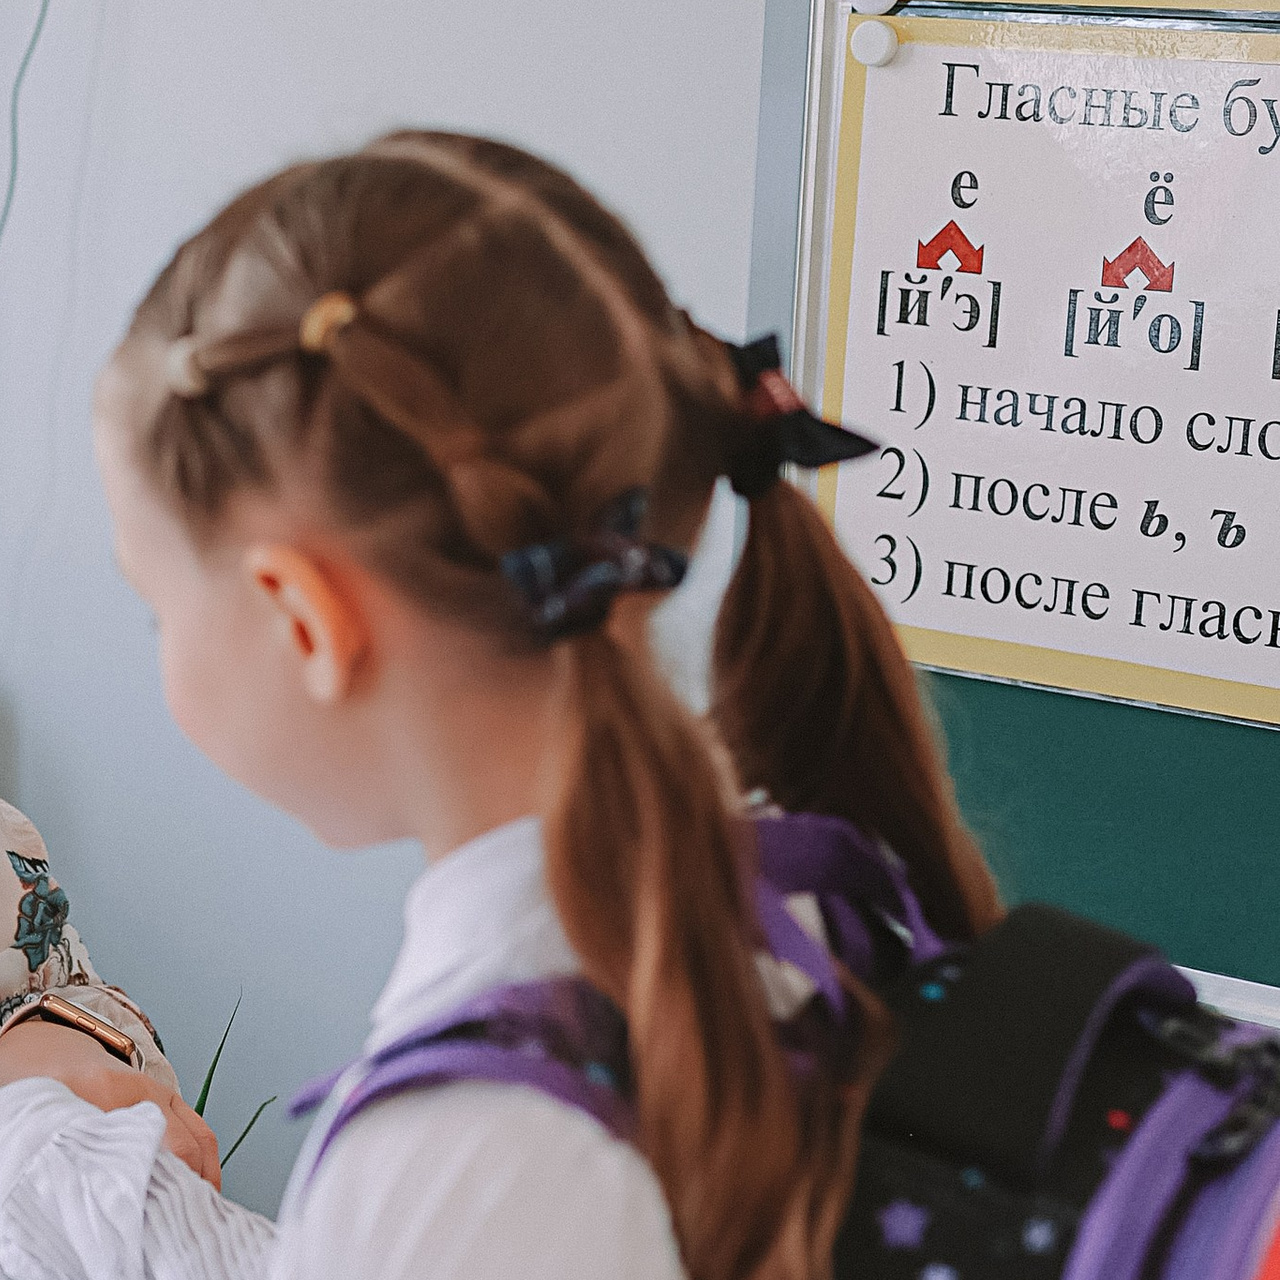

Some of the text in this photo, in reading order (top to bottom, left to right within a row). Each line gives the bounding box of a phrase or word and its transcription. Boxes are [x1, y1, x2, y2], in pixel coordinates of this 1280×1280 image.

[938, 63, 1280, 155] Гласные бу
[951, 171, 1174, 225] е ё
[890, 360, 936, 430] 1)
[956, 384, 1163, 444] начало
[876, 447, 929, 517] 2)
[949, 472, 1118, 530] после
[1210, 509, 1246, 548] ъ
[870, 534, 922, 604] 3)
[942, 561, 1110, 620] после
